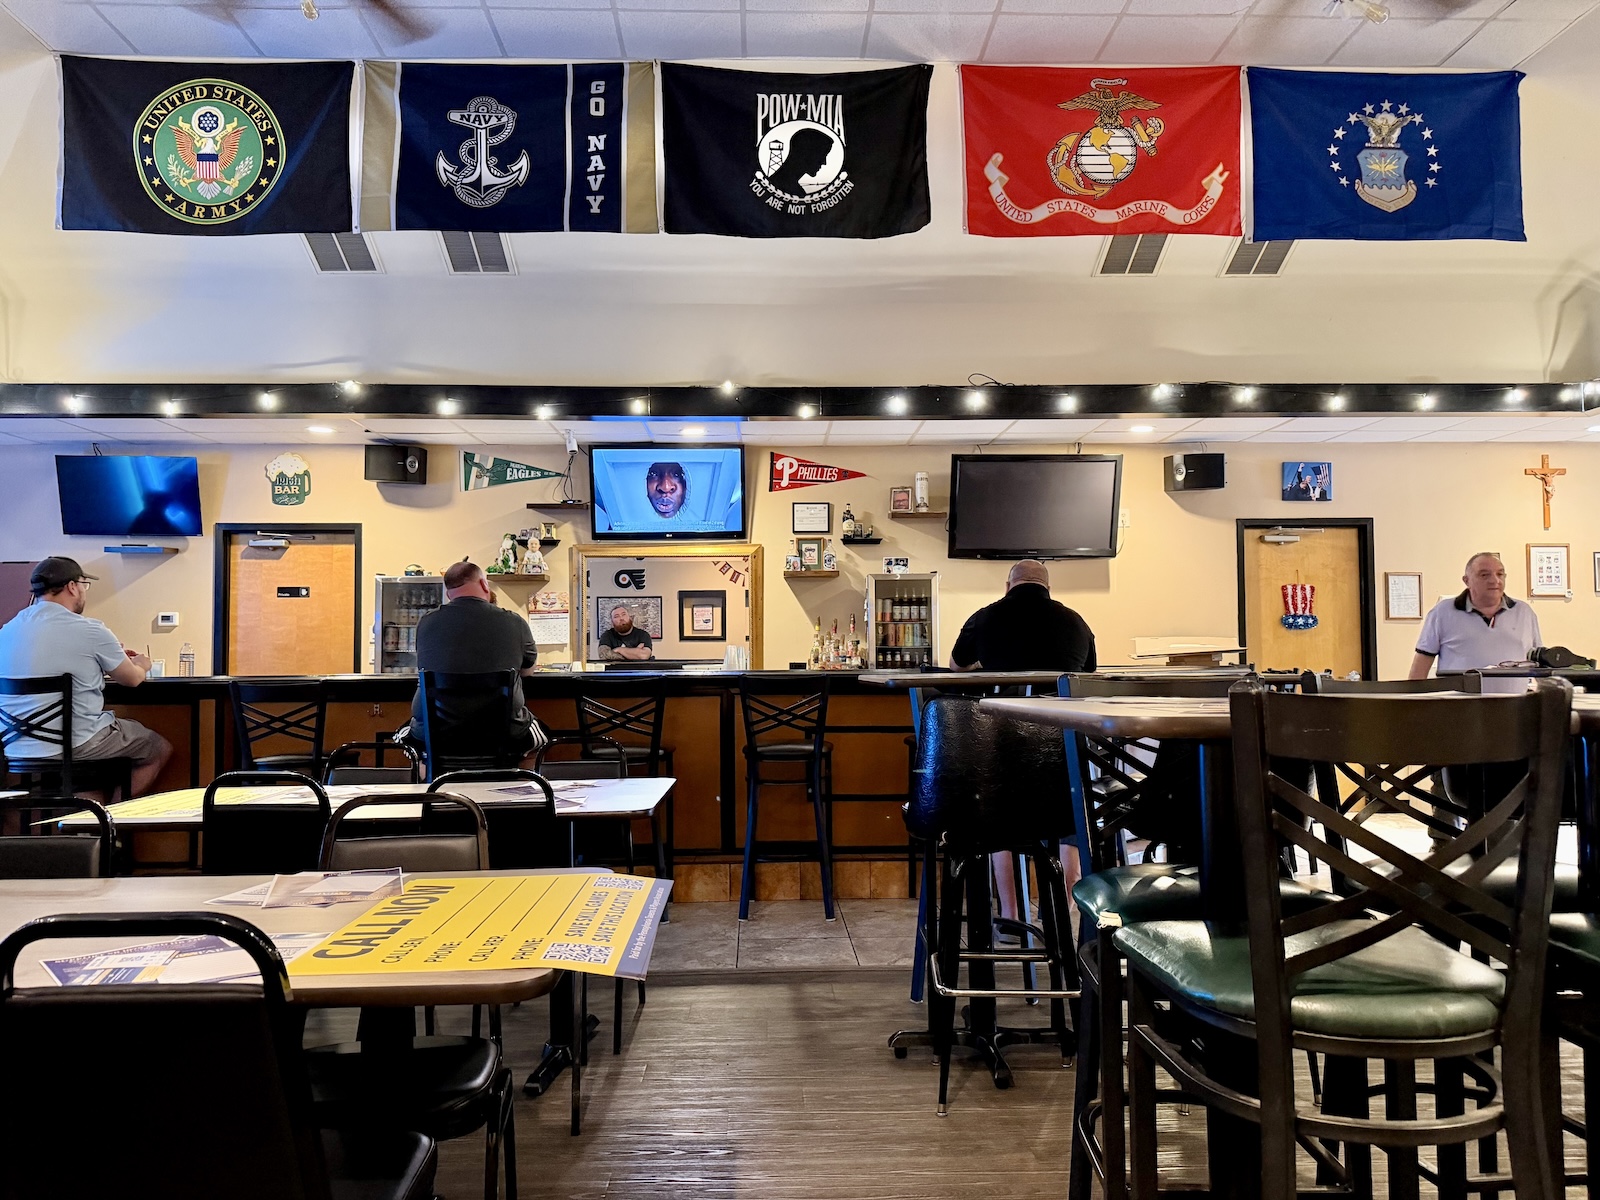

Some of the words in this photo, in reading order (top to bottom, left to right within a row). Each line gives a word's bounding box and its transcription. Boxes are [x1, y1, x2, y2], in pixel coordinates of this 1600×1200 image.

[589, 81, 606, 117] GO
[144, 86, 207, 129] UNITED
[213, 86, 272, 132] STATES
[459, 113, 507, 126] NAVY
[756, 93, 802, 147] POW
[806, 94, 846, 147] MIA
[586, 133, 607, 214] NAVY
[749, 179, 766, 197] YOU
[765, 196, 784, 211] ARE
[787, 204, 806, 215] NOT
[811, 180, 855, 213] FORGOTTEN
[174, 200, 242, 218] ARMY
[994, 192, 1033, 223] UNITED
[1046, 200, 1097, 219] STATES
[1115, 201, 1168, 221] MARINE
[1182, 195, 1215, 224] CORPS
[506, 467, 542, 480] EAGLES
[797, 466, 839, 481] PHILLIES
[274, 485, 300, 495] BAR
[585, 891, 610, 908] GAMES
[607, 891, 635, 914] LOCATION
[312, 918, 413, 958] CALL
[372, 885, 456, 916] NOW
[575, 908, 600, 922] SKILL
[600, 914, 623, 927] THIS
[565, 922, 591, 937] SAVE
[592, 926, 616, 943] SAVE
[381, 947, 413, 963] CALL
[400, 936, 428, 948] SEN.
[482, 934, 508, 947] REP.
[511, 938, 544, 960] PHONE:
[423, 941, 463, 963] PHONE:
[468, 946, 497, 962] CALL
